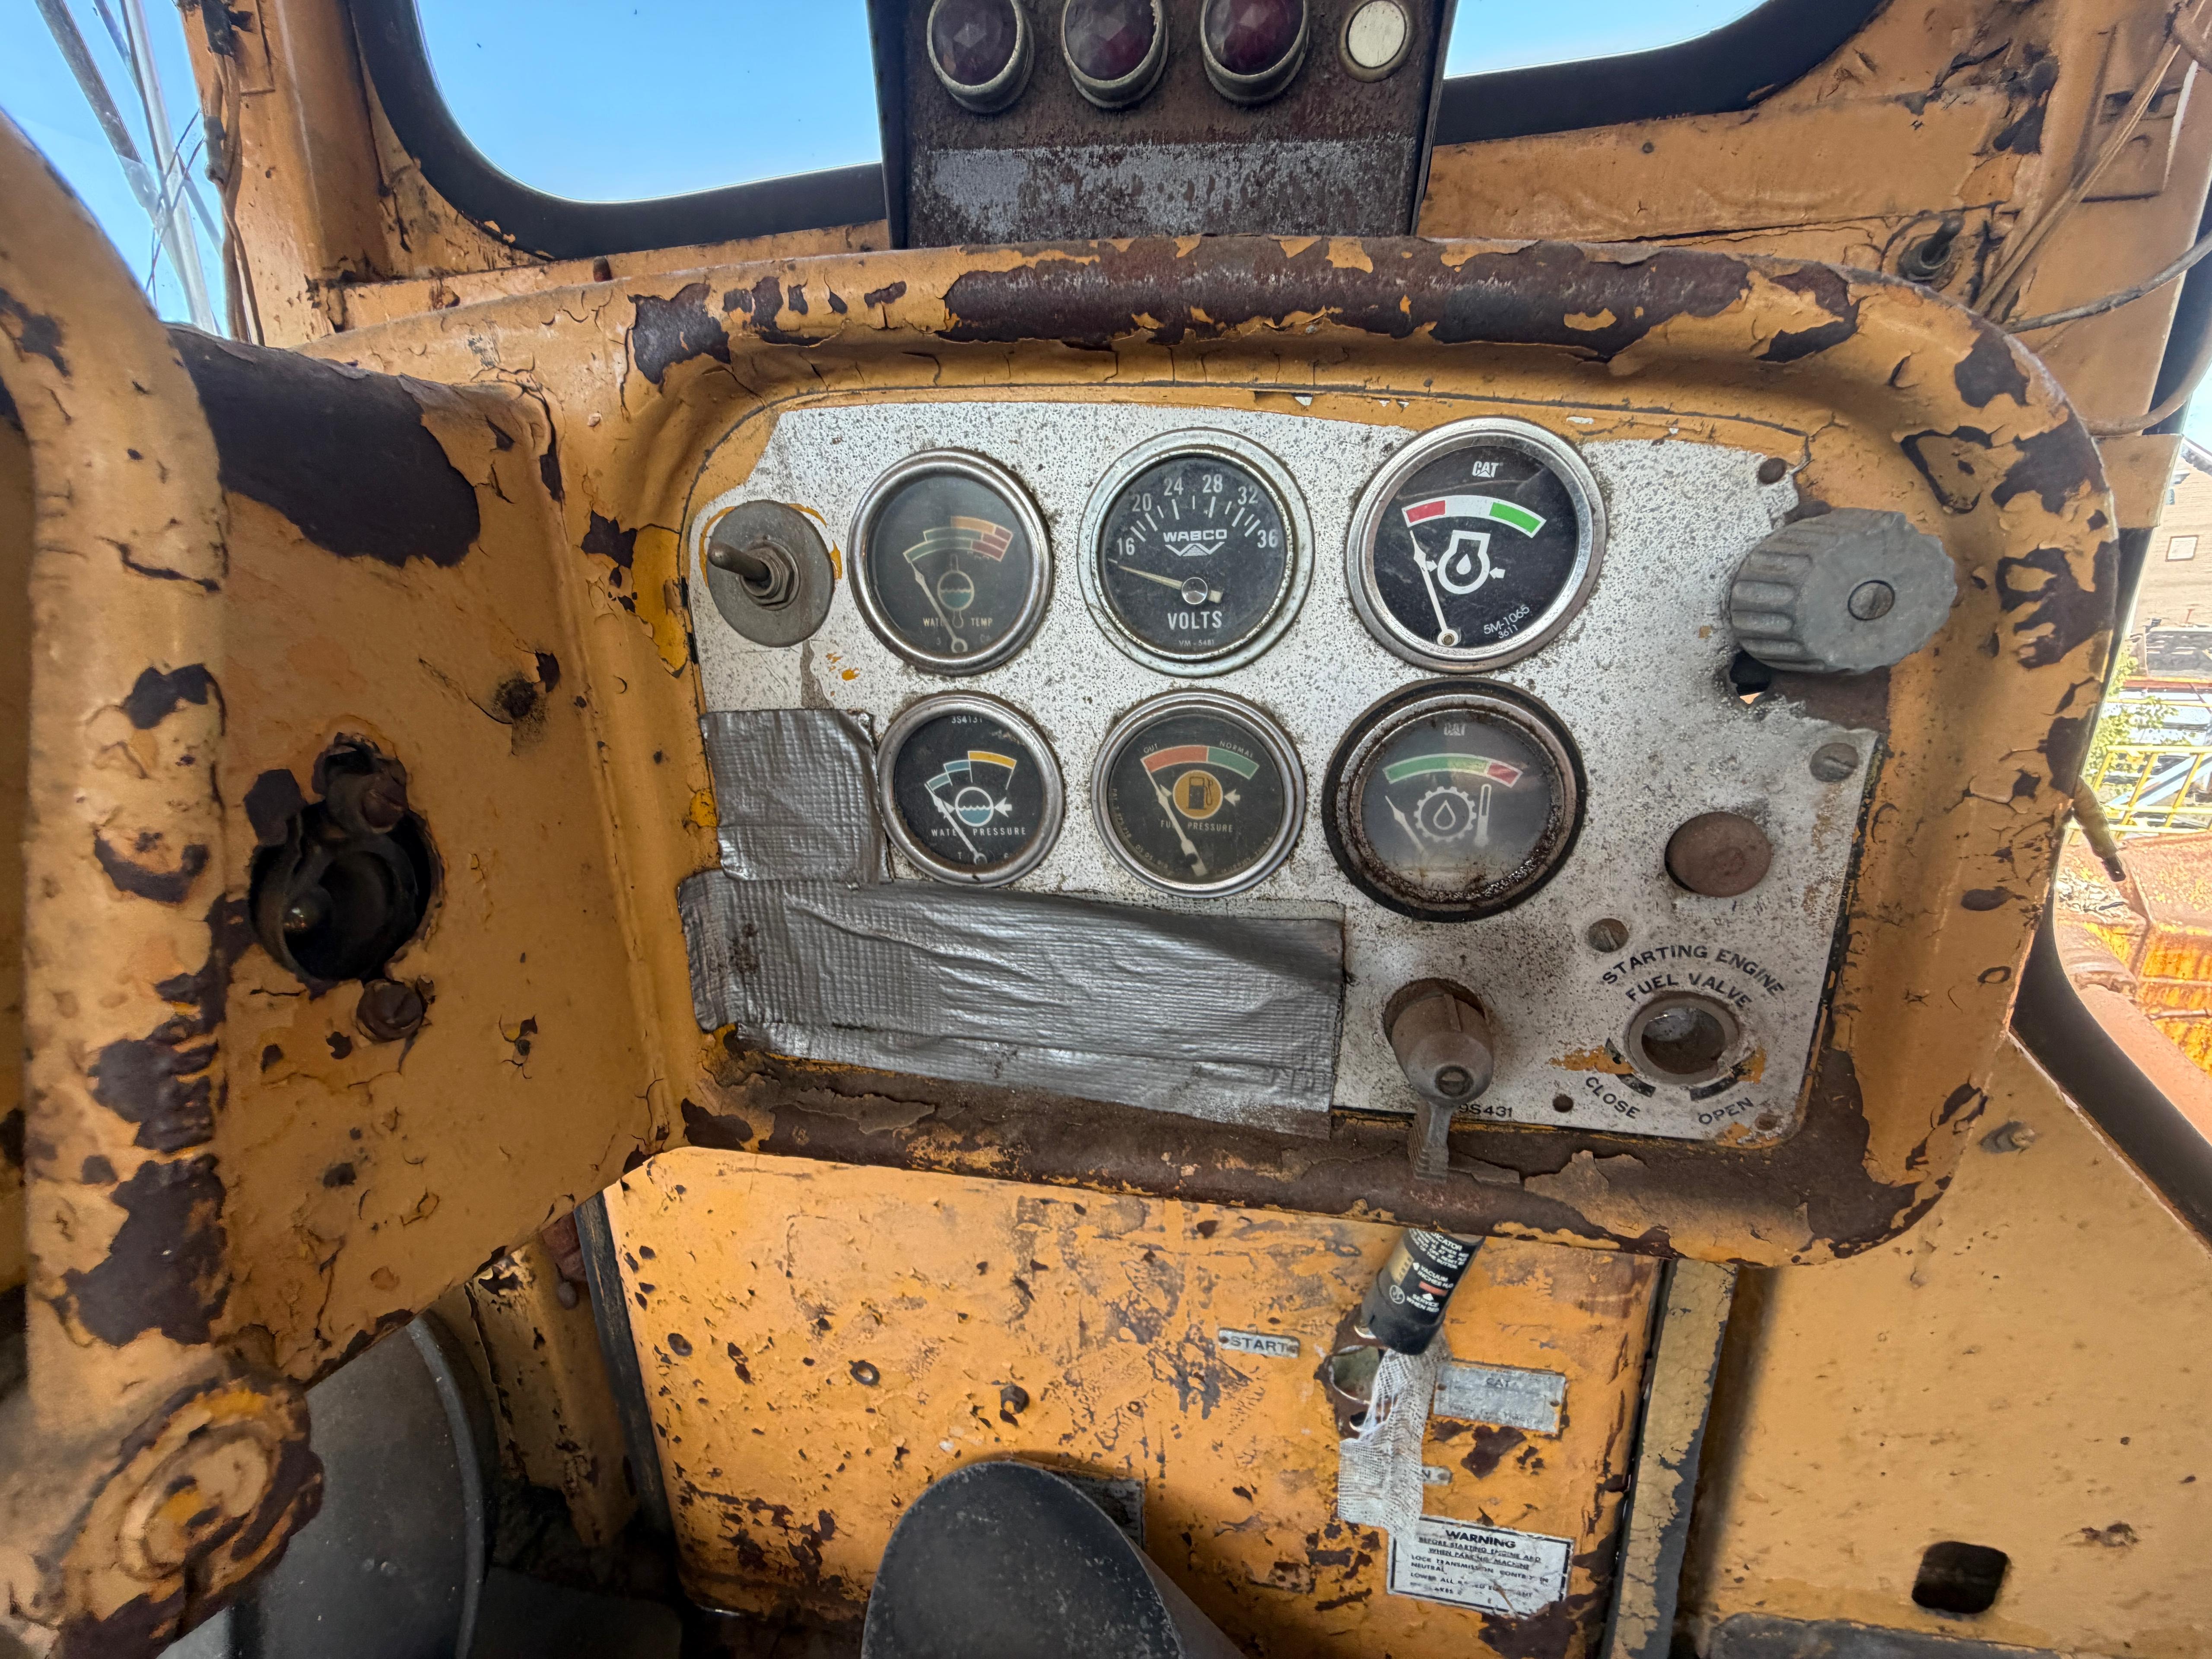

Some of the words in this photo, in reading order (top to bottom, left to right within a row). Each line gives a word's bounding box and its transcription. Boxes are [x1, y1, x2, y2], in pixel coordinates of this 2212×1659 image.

[1472, 461, 1499, 478] CAT
[1117, 537, 1135, 556] 16
[1132, 493, 1152, 512] 20
[1163, 477, 1184, 496] 24
[1202, 474, 1223, 493] 28
[1238, 486, 1258, 505] 32
[1257, 529, 1278, 548] 36
[1163, 529, 1227, 542] WABCO
[923, 617, 947, 627] WAT
[971, 617, 993, 627] TEMP
[1167, 610, 1222, 630] VOLTS
[1484, 604, 1530, 634] 5M-1065
[1498, 625, 1518, 638] 3611
[931, 828, 962, 836] WATE
[973, 827, 1026, 836] PRESSURE
[1161, 819, 1177, 829] FU
[1188, 822, 1233, 833] PRESSURE
[1603, 945, 1708, 985] STARTING
[1715, 949, 1785, 995] ENGINE
[1625, 974, 1679, 1002] FUEL
[1689, 973, 1752, 1008] VALVE
[1586, 1077, 1640, 1119] CLOSE
[1699, 1097, 1754, 1124] OPEN
[1230, 1336, 1286, 1352] START
[1446, 1530, 1516, 1548] WARNING
[1428, 1548, 1452, 1557] WHEN
[1436, 1558, 1494, 1573] TRANSMISSON
[1500, 1570, 1533, 1580] CONTR
